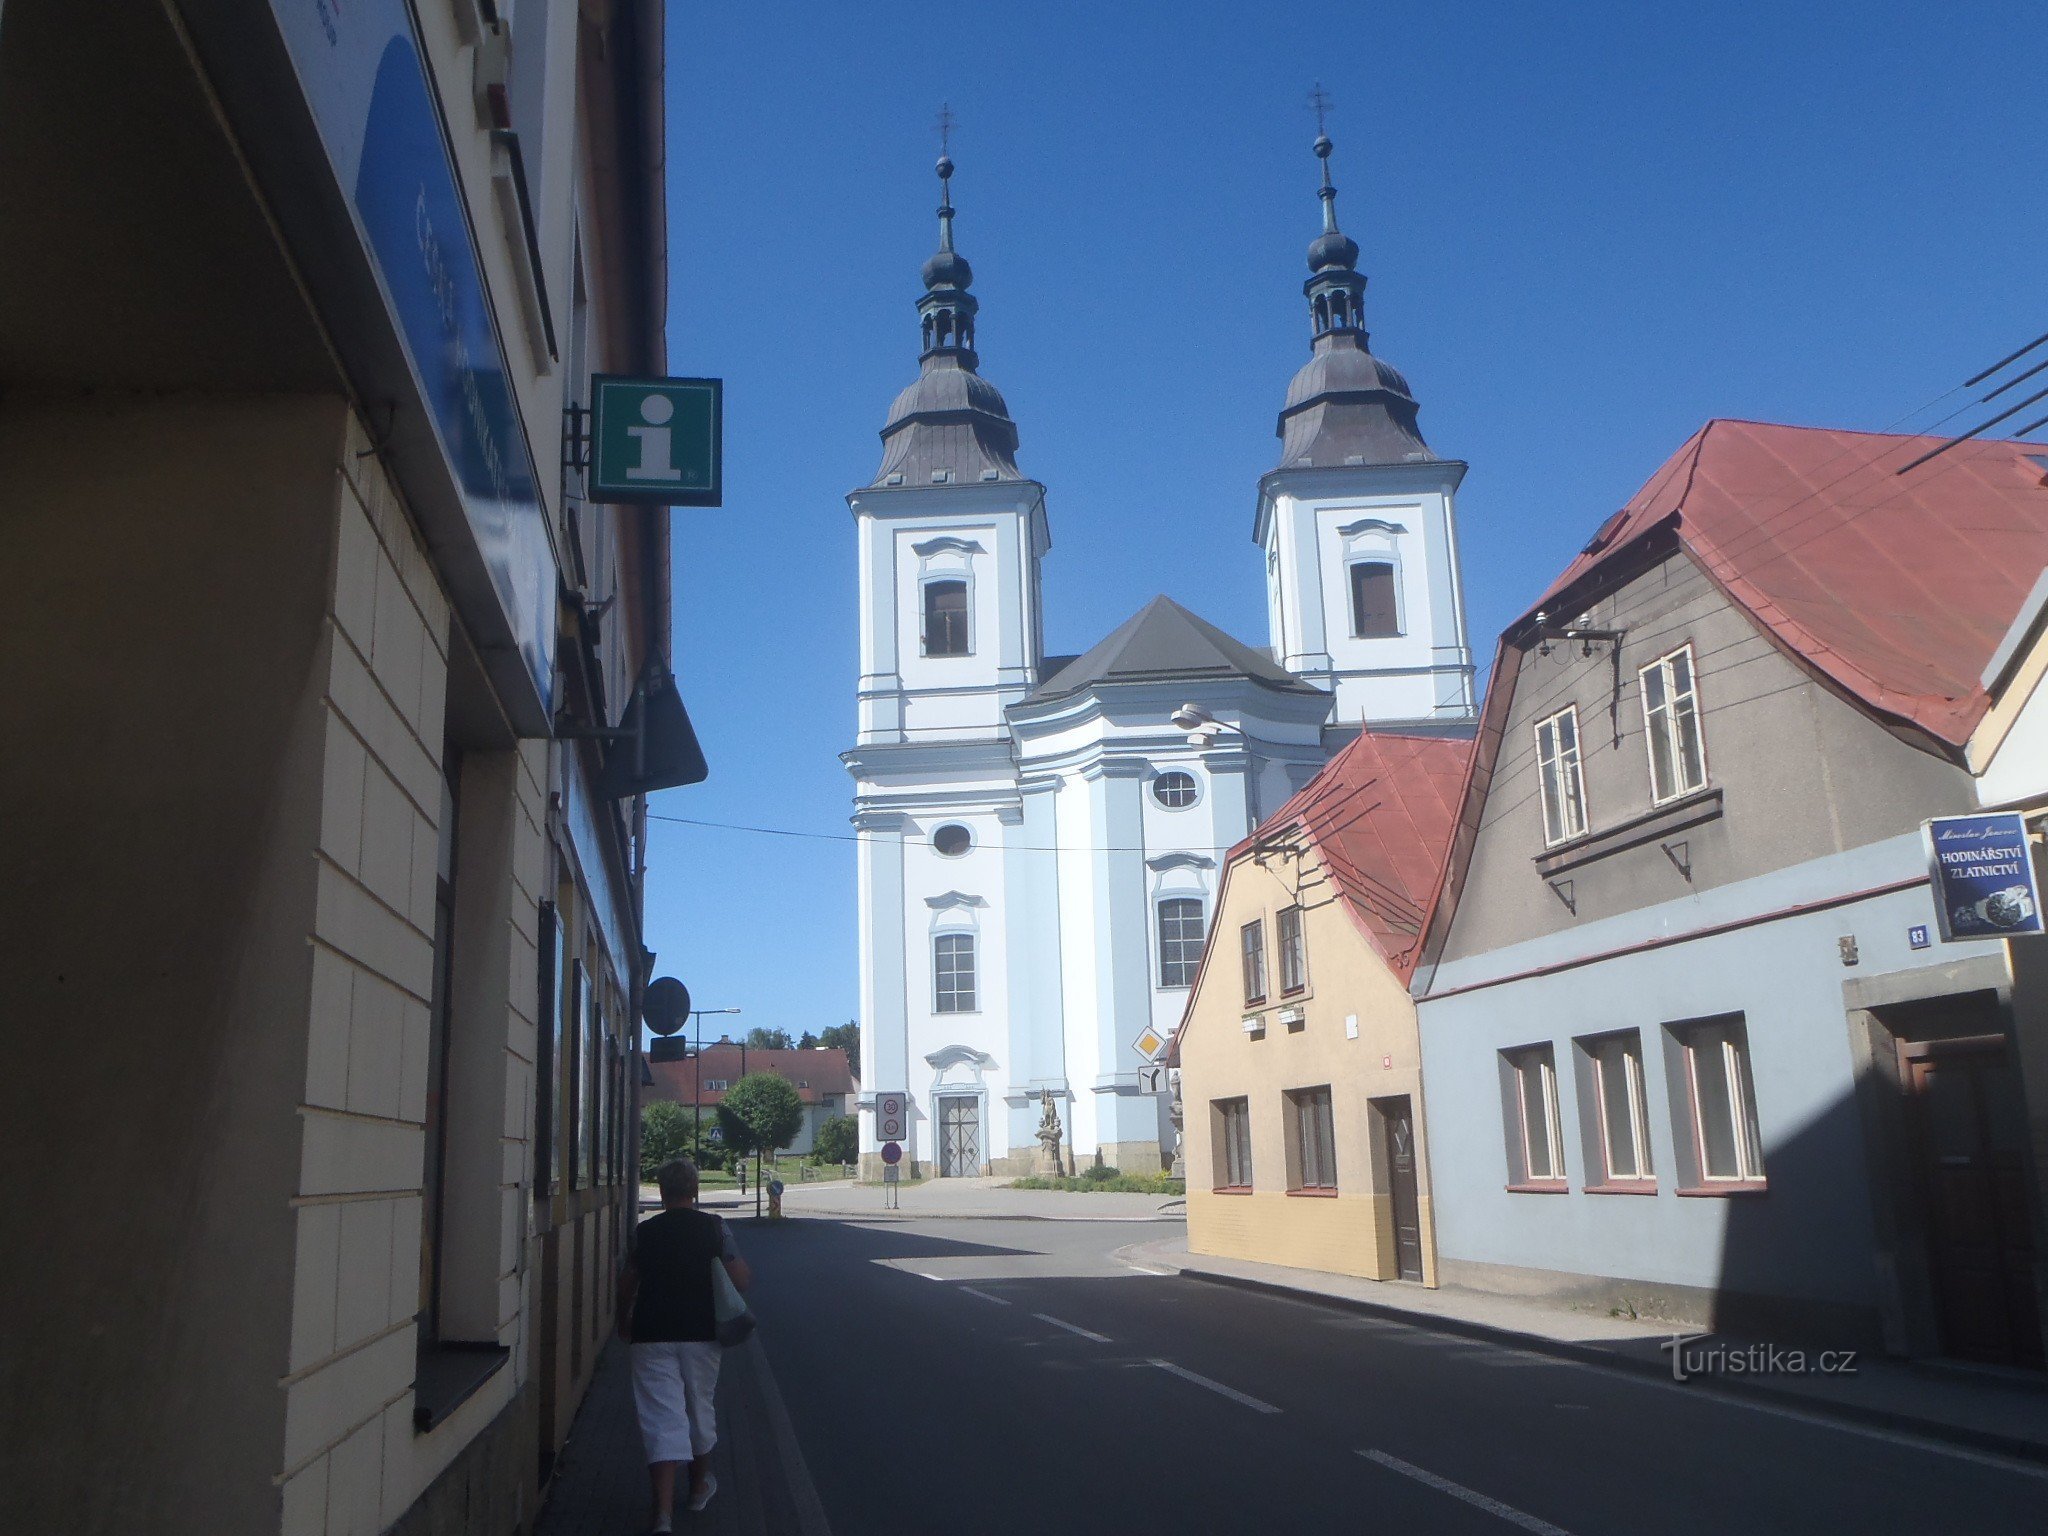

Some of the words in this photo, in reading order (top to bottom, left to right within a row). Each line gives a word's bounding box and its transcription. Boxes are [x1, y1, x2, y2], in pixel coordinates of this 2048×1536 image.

[1941, 845, 2022, 864] HODINÁŘSTVÍ
[1950, 861, 2019, 879] ZLATNICTVÍ
[1911, 930, 1924, 943] 83
